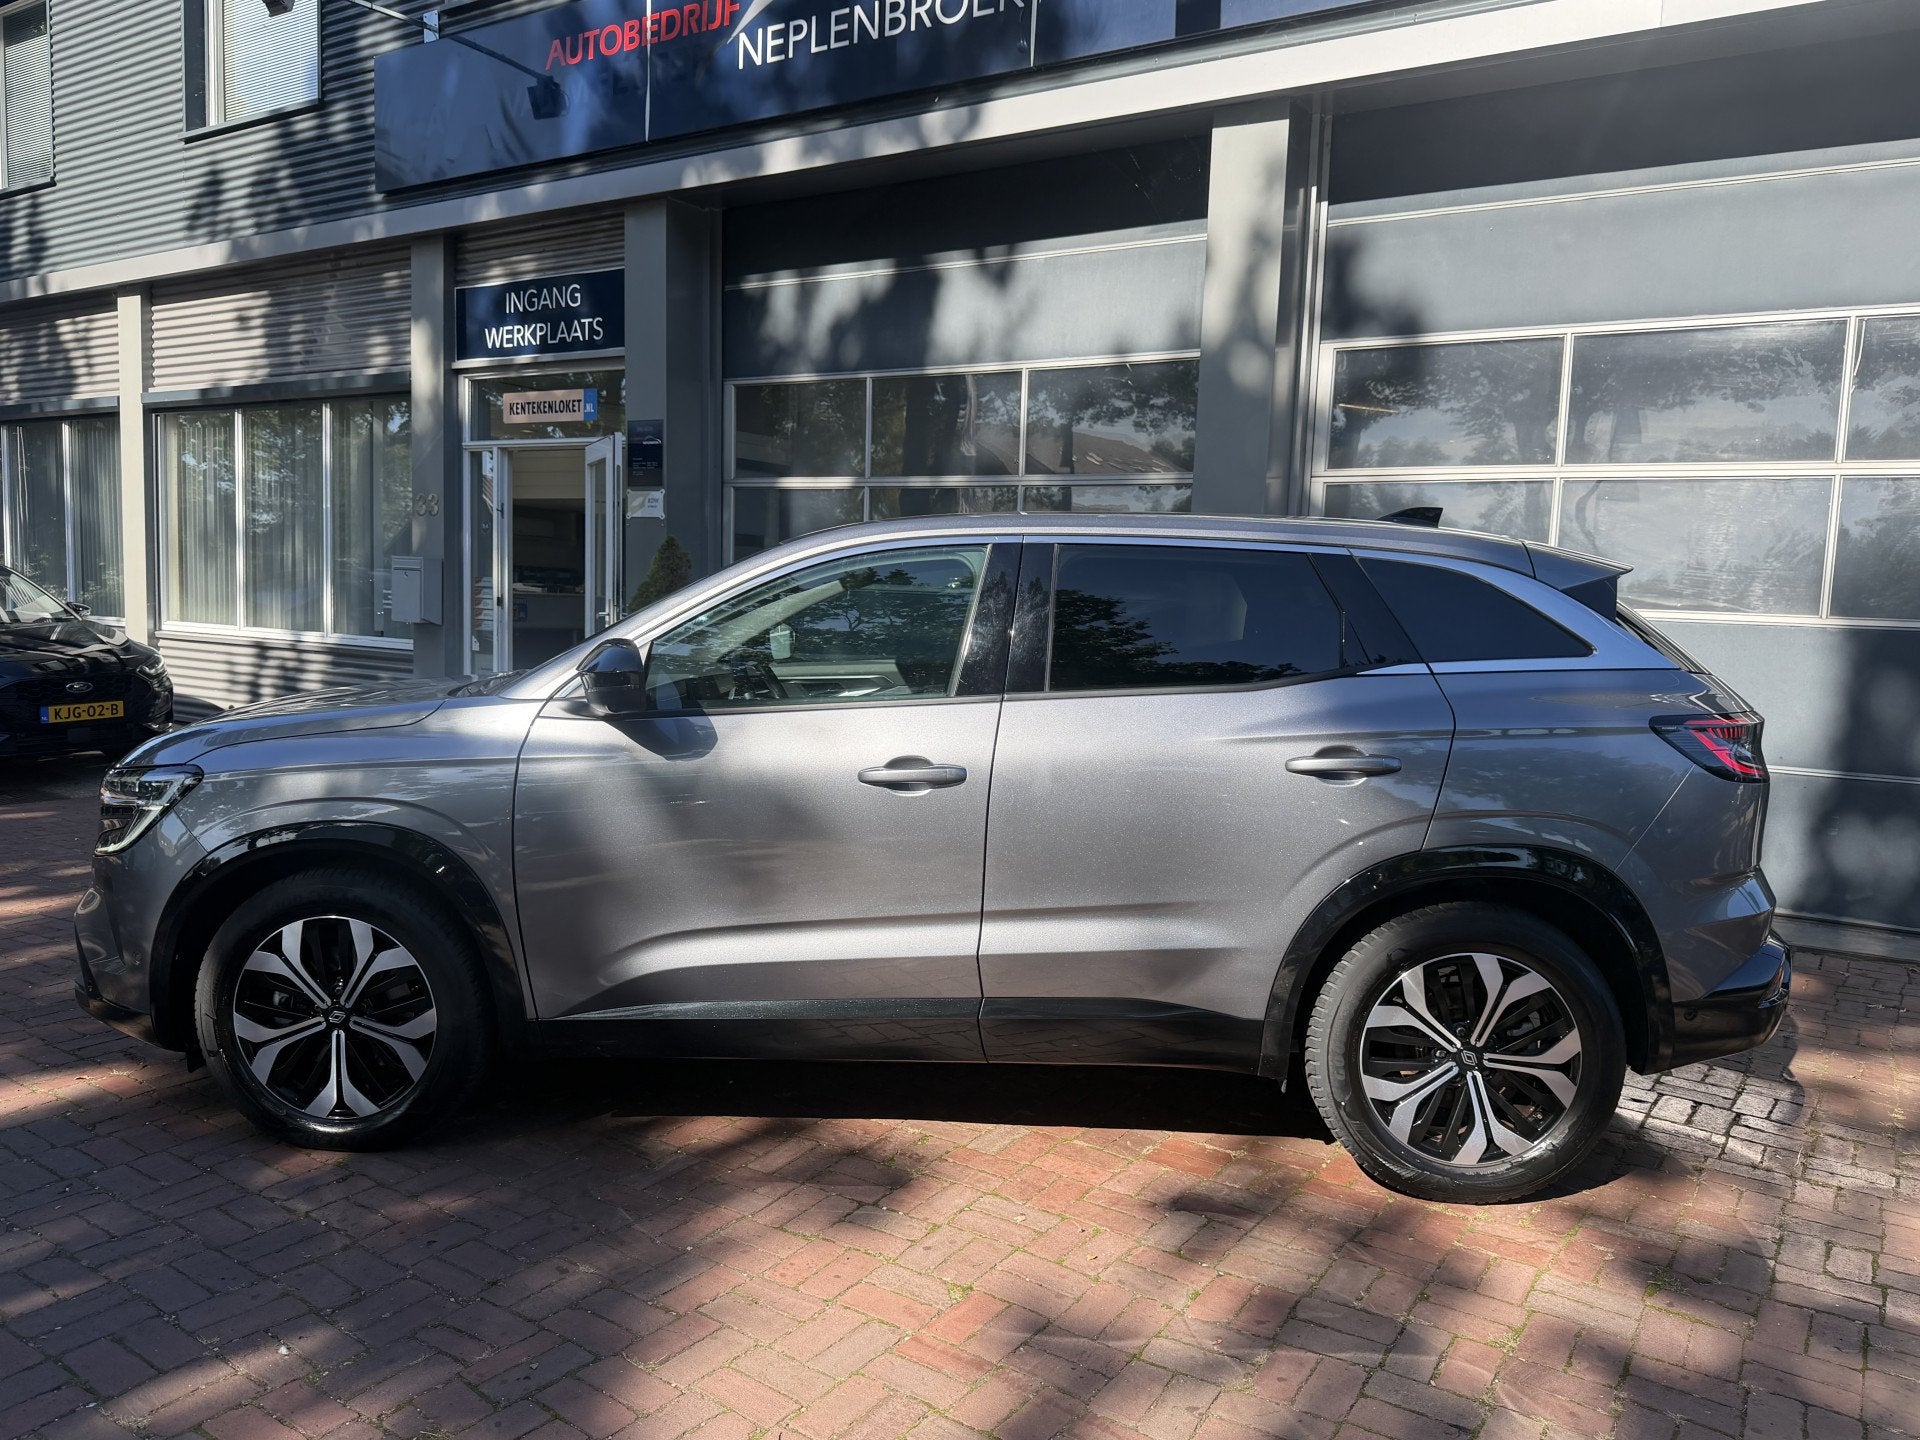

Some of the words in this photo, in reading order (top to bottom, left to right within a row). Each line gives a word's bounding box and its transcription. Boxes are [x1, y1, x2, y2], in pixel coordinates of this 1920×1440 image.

[545, 0, 740, 71] AUTOBEDRIJF
[505, 284, 581, 314] INGANG
[484, 317, 604, 349] WERKPLAATS
[54, 703, 119, 720] KJG-02-B
